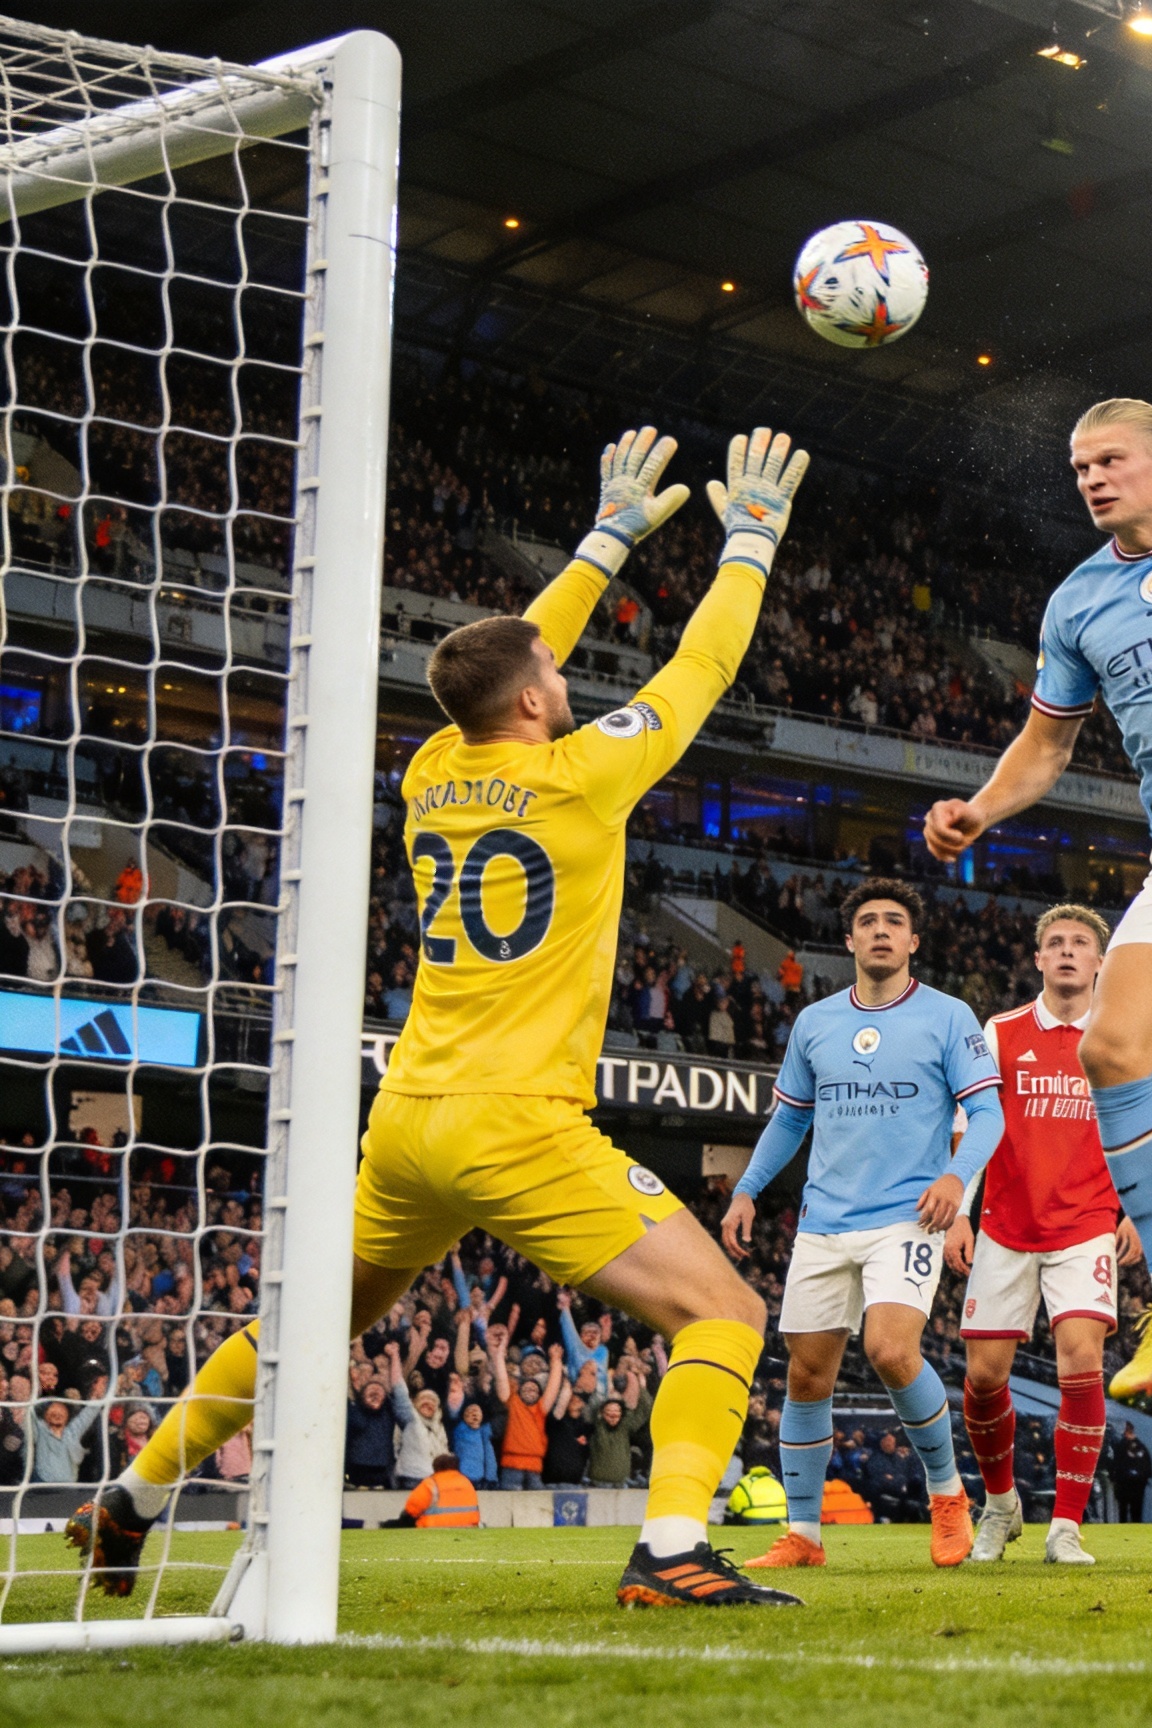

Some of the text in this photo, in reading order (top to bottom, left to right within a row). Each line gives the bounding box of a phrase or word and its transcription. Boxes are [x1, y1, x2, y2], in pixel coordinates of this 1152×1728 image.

[411, 827, 556, 966] 20
[819, 1081, 919, 1102] ETIHAD
[901, 1240, 933, 1277] 18
